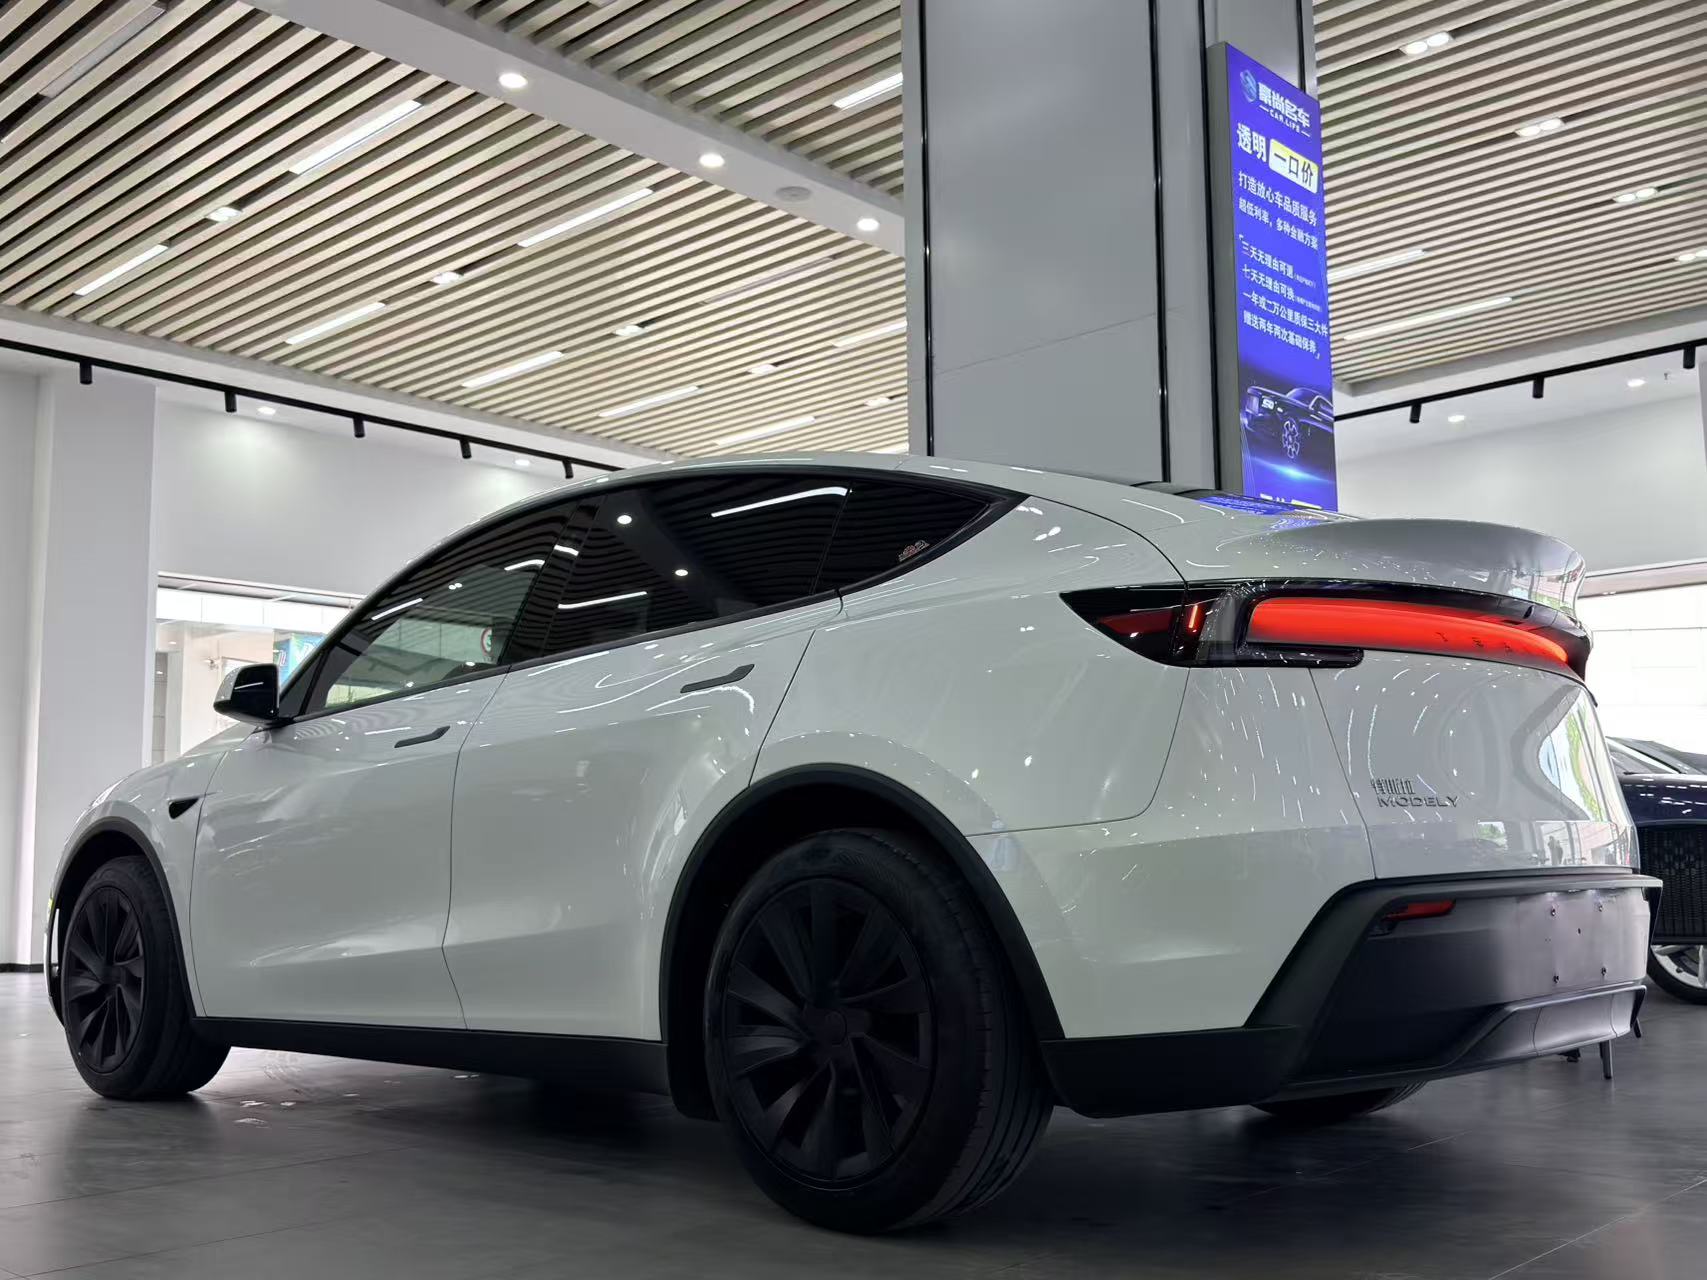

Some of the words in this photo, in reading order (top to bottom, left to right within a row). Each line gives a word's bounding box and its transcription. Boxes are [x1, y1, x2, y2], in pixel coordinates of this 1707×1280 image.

[1236, 122, 1267, 162] 透明
[1273, 152, 1314, 187] 一口价
[1238, 170, 1318, 227] 打造放心车品质服务
